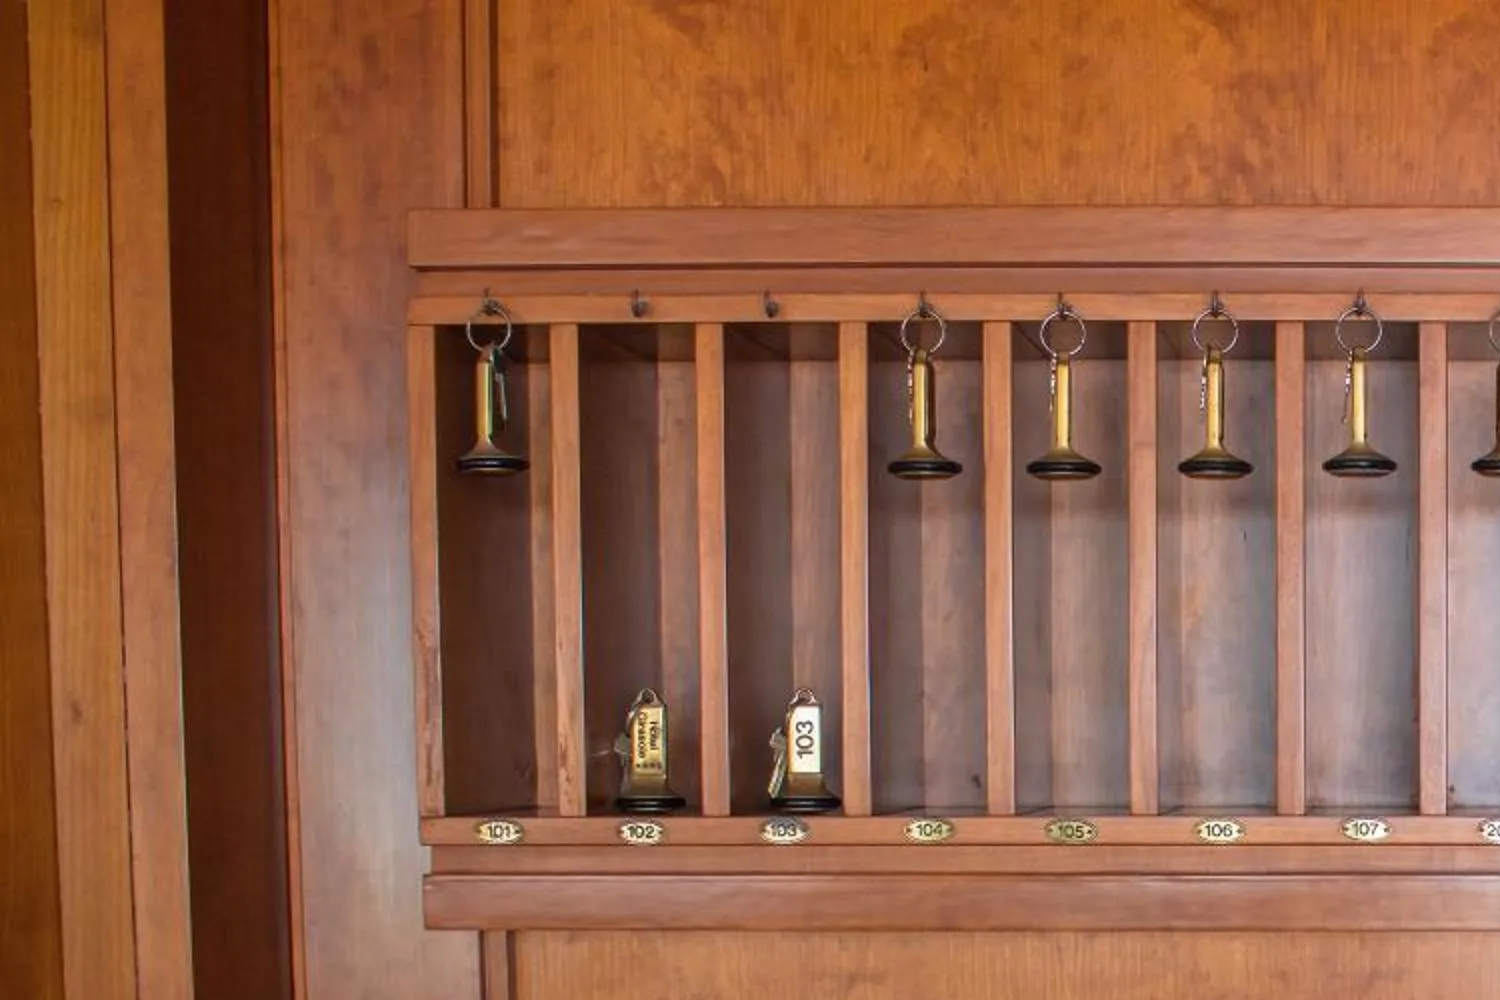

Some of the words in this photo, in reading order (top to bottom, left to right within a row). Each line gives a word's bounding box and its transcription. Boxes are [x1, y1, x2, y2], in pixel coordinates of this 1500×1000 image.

[796, 719, 814, 758] 103
[488, 825, 511, 837] 101
[628, 826, 655, 838] 102
[771, 824, 797, 837] 103
[917, 825, 943, 836] 104
[1058, 825, 1085, 838] 105
[1205, 825, 1233, 837] 106
[1352, 824, 1379, 836] 107
